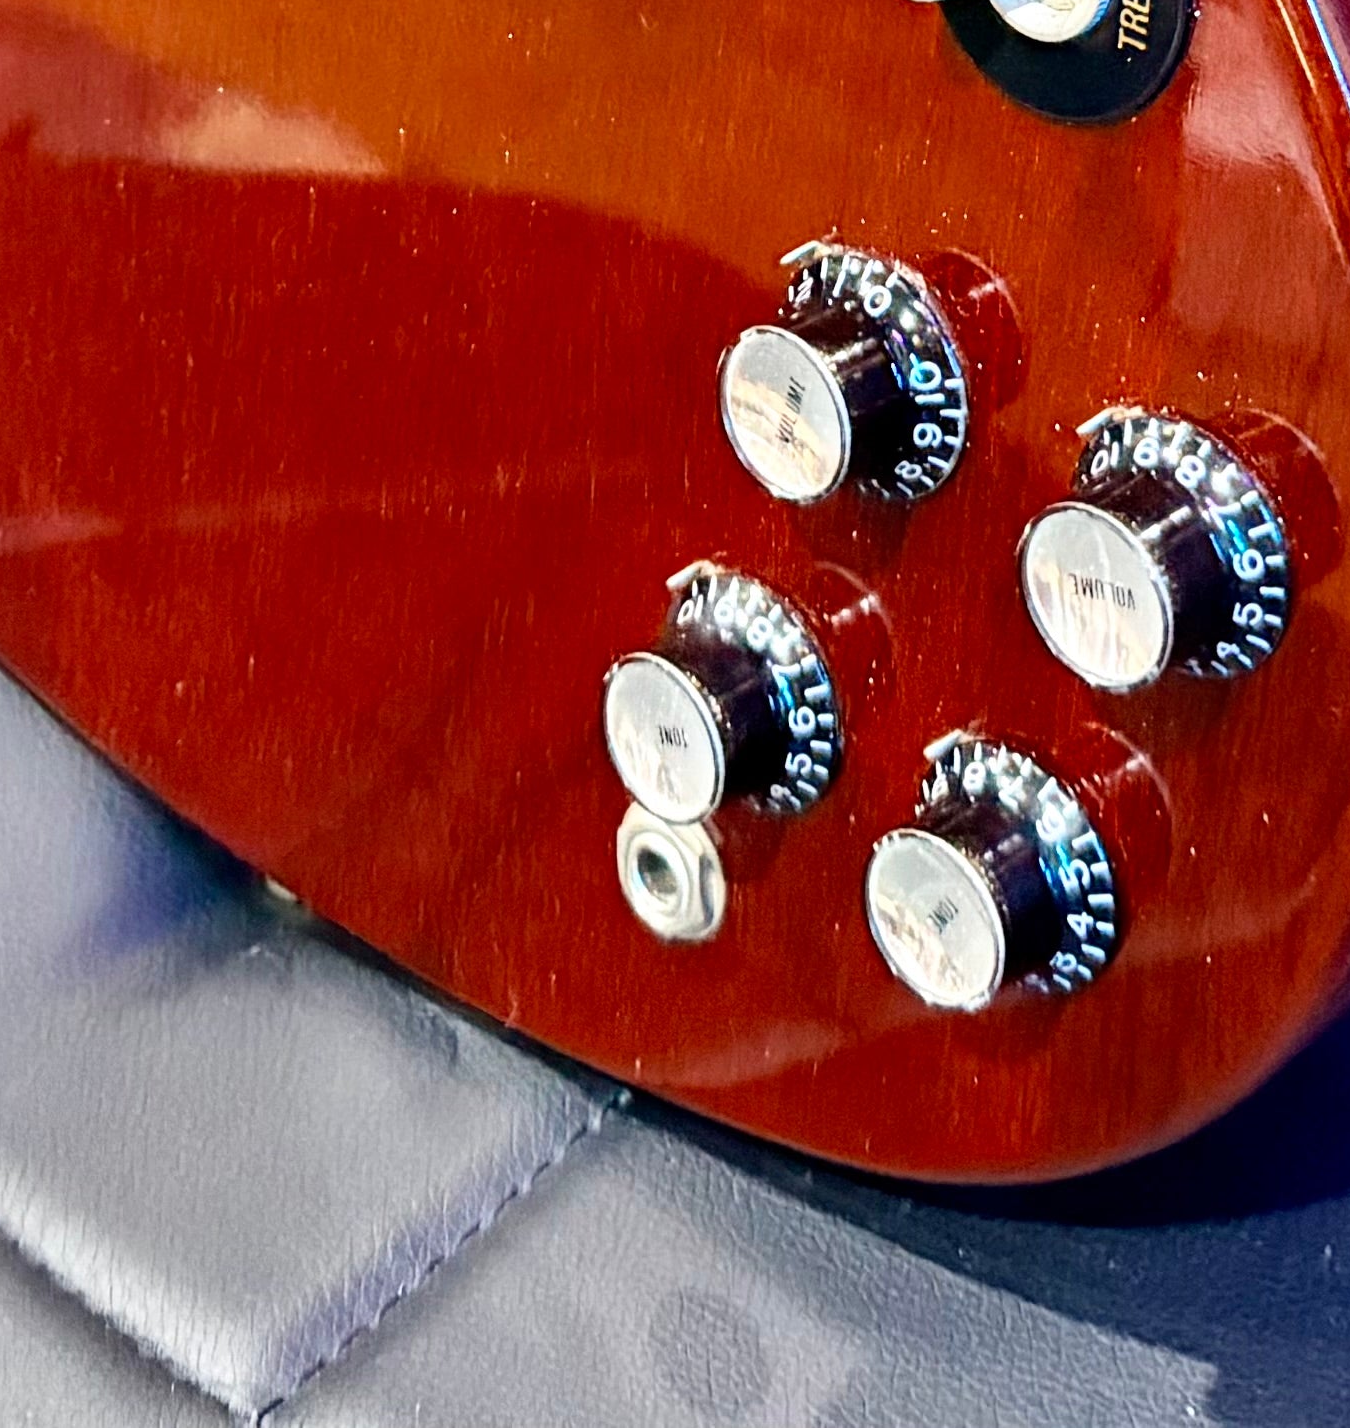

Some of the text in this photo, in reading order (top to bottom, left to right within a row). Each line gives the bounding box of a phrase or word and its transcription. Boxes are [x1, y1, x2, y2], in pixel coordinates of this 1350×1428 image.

[1068, 571, 1137, 612] VOLUME
[1232, 601, 1264, 629] 5
[1066, 911, 1095, 942] 4
